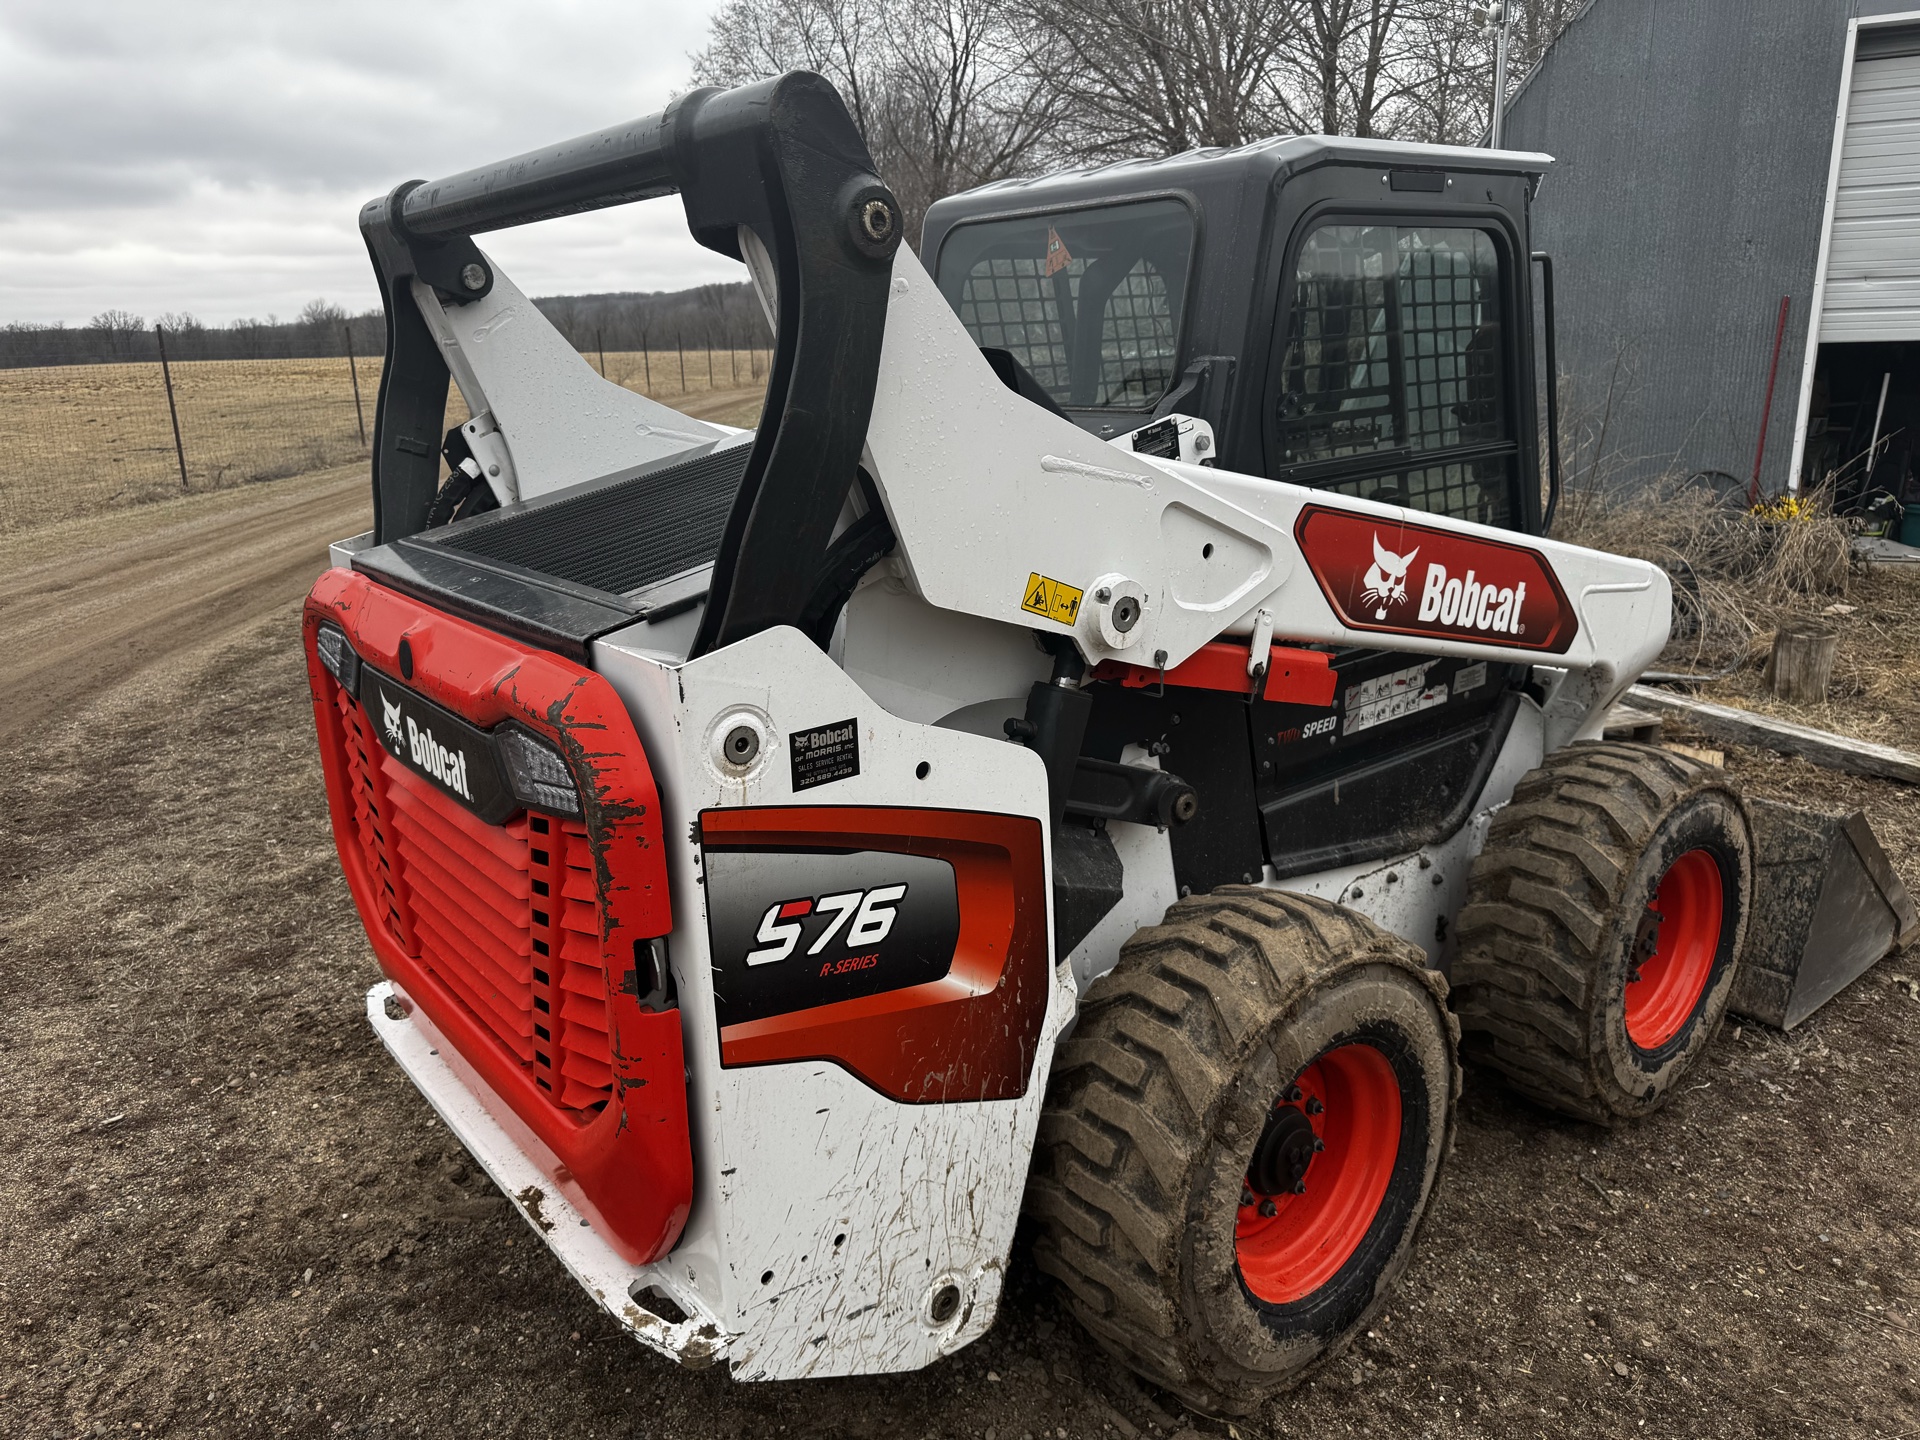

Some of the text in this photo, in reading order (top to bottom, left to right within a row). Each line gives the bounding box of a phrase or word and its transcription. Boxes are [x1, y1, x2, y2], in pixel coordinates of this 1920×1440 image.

[1417, 562, 1526, 635] Bobcat
[810, 724, 854, 749] Bobcat
[1302, 716, 1337, 739] SPEED
[406, 716, 470, 801] Bobcat
[798, 762, 813, 772] SALES
[815, 757, 835, 768] SERVICE
[836, 753, 854, 762] RENTAL
[799, 766, 853, 786] 320.589.4439
[746, 884, 907, 967] S76
[819, 954, 879, 977] R-SERIES
